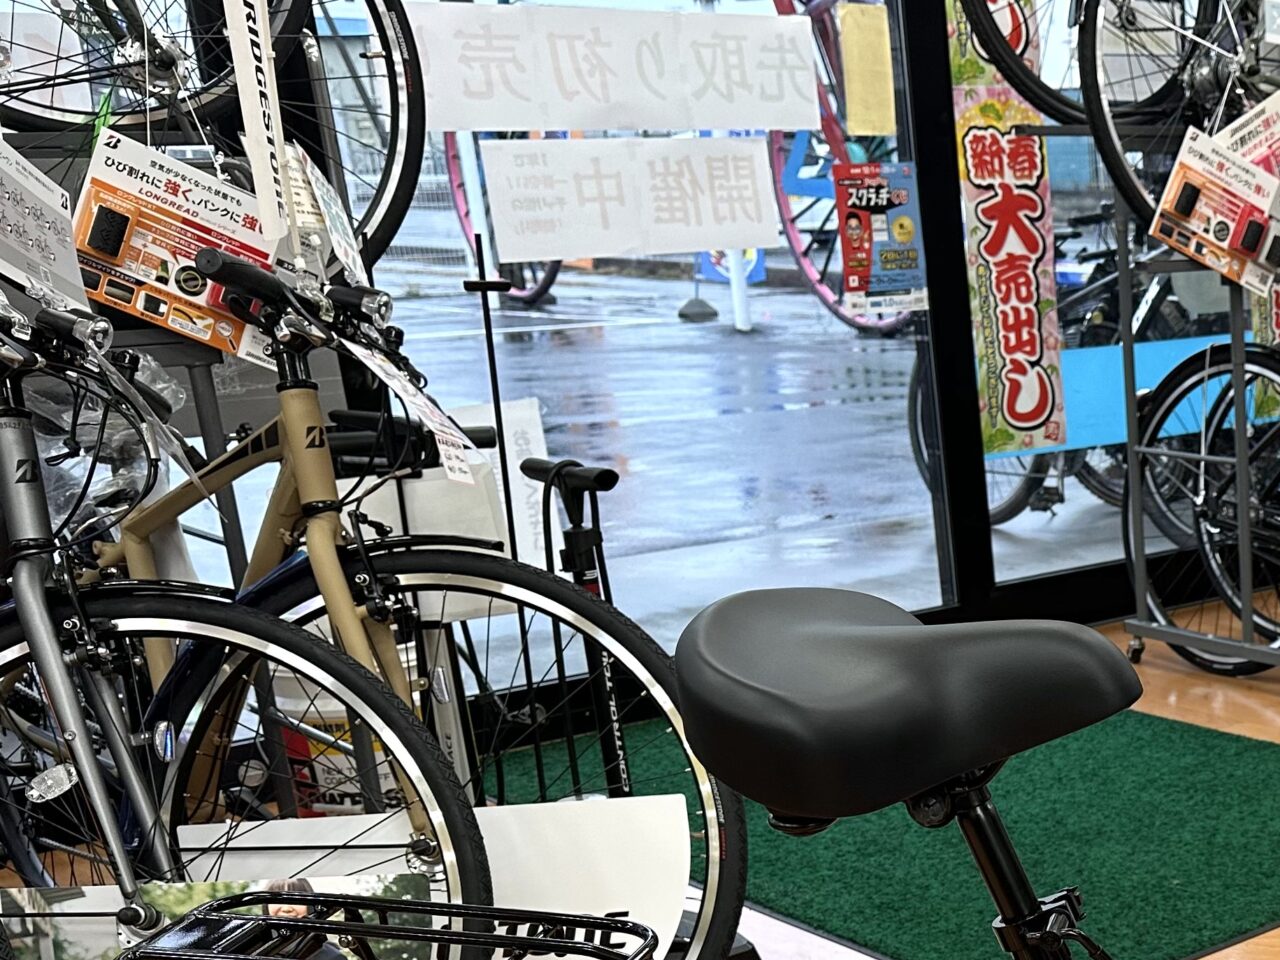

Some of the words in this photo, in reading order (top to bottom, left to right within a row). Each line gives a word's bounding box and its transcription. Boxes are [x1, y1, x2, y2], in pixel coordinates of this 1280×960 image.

[138, 187, 199, 218] LONGREAD
[149, 159, 242, 207] 空気が少なくなった状態でも
[982, 183, 1052, 427] 大売出し
